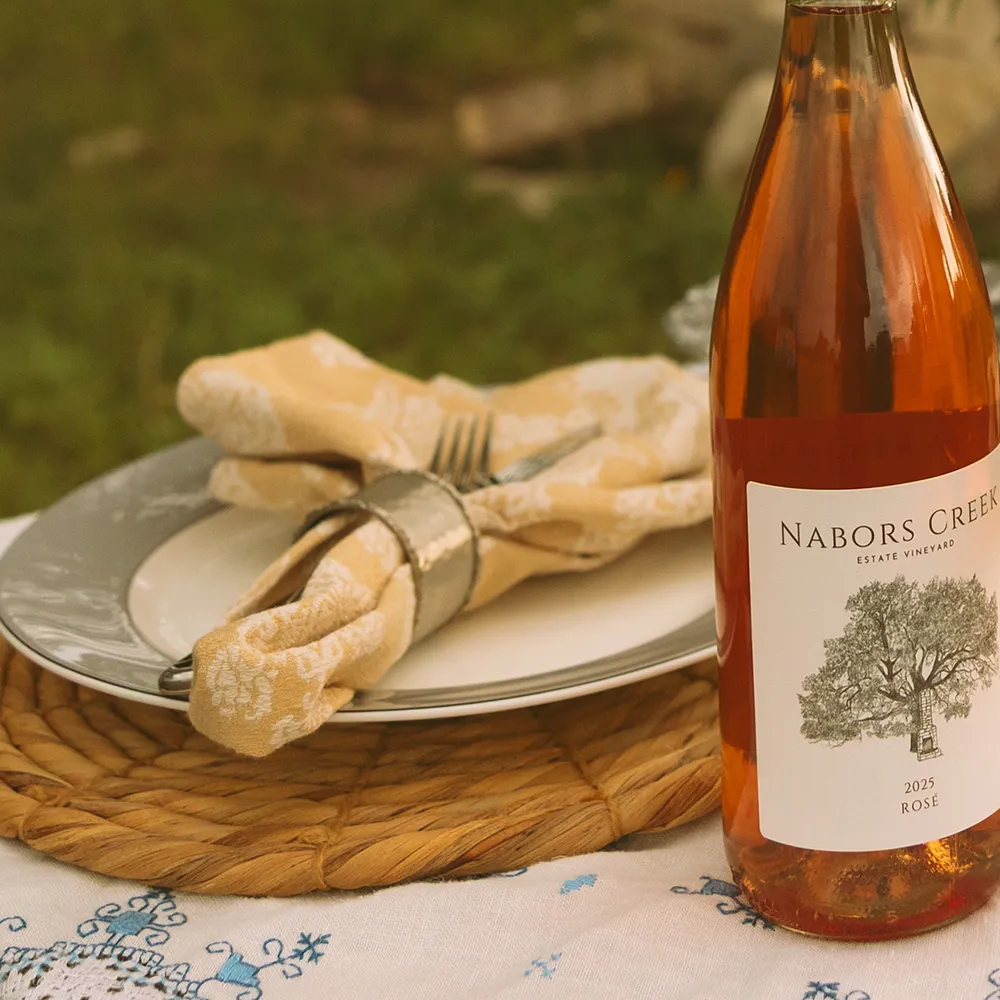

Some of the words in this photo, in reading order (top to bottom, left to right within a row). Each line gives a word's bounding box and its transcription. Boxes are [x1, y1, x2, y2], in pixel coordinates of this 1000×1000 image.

[780, 518, 915, 549] NABORS
[928, 485, 999, 536] CREEK
[857, 552, 898, 564] ESTATE
[903, 539, 955, 558] VINEYARD
[904, 776, 935, 794] 2025
[901, 792, 939, 814] ROSÉ
